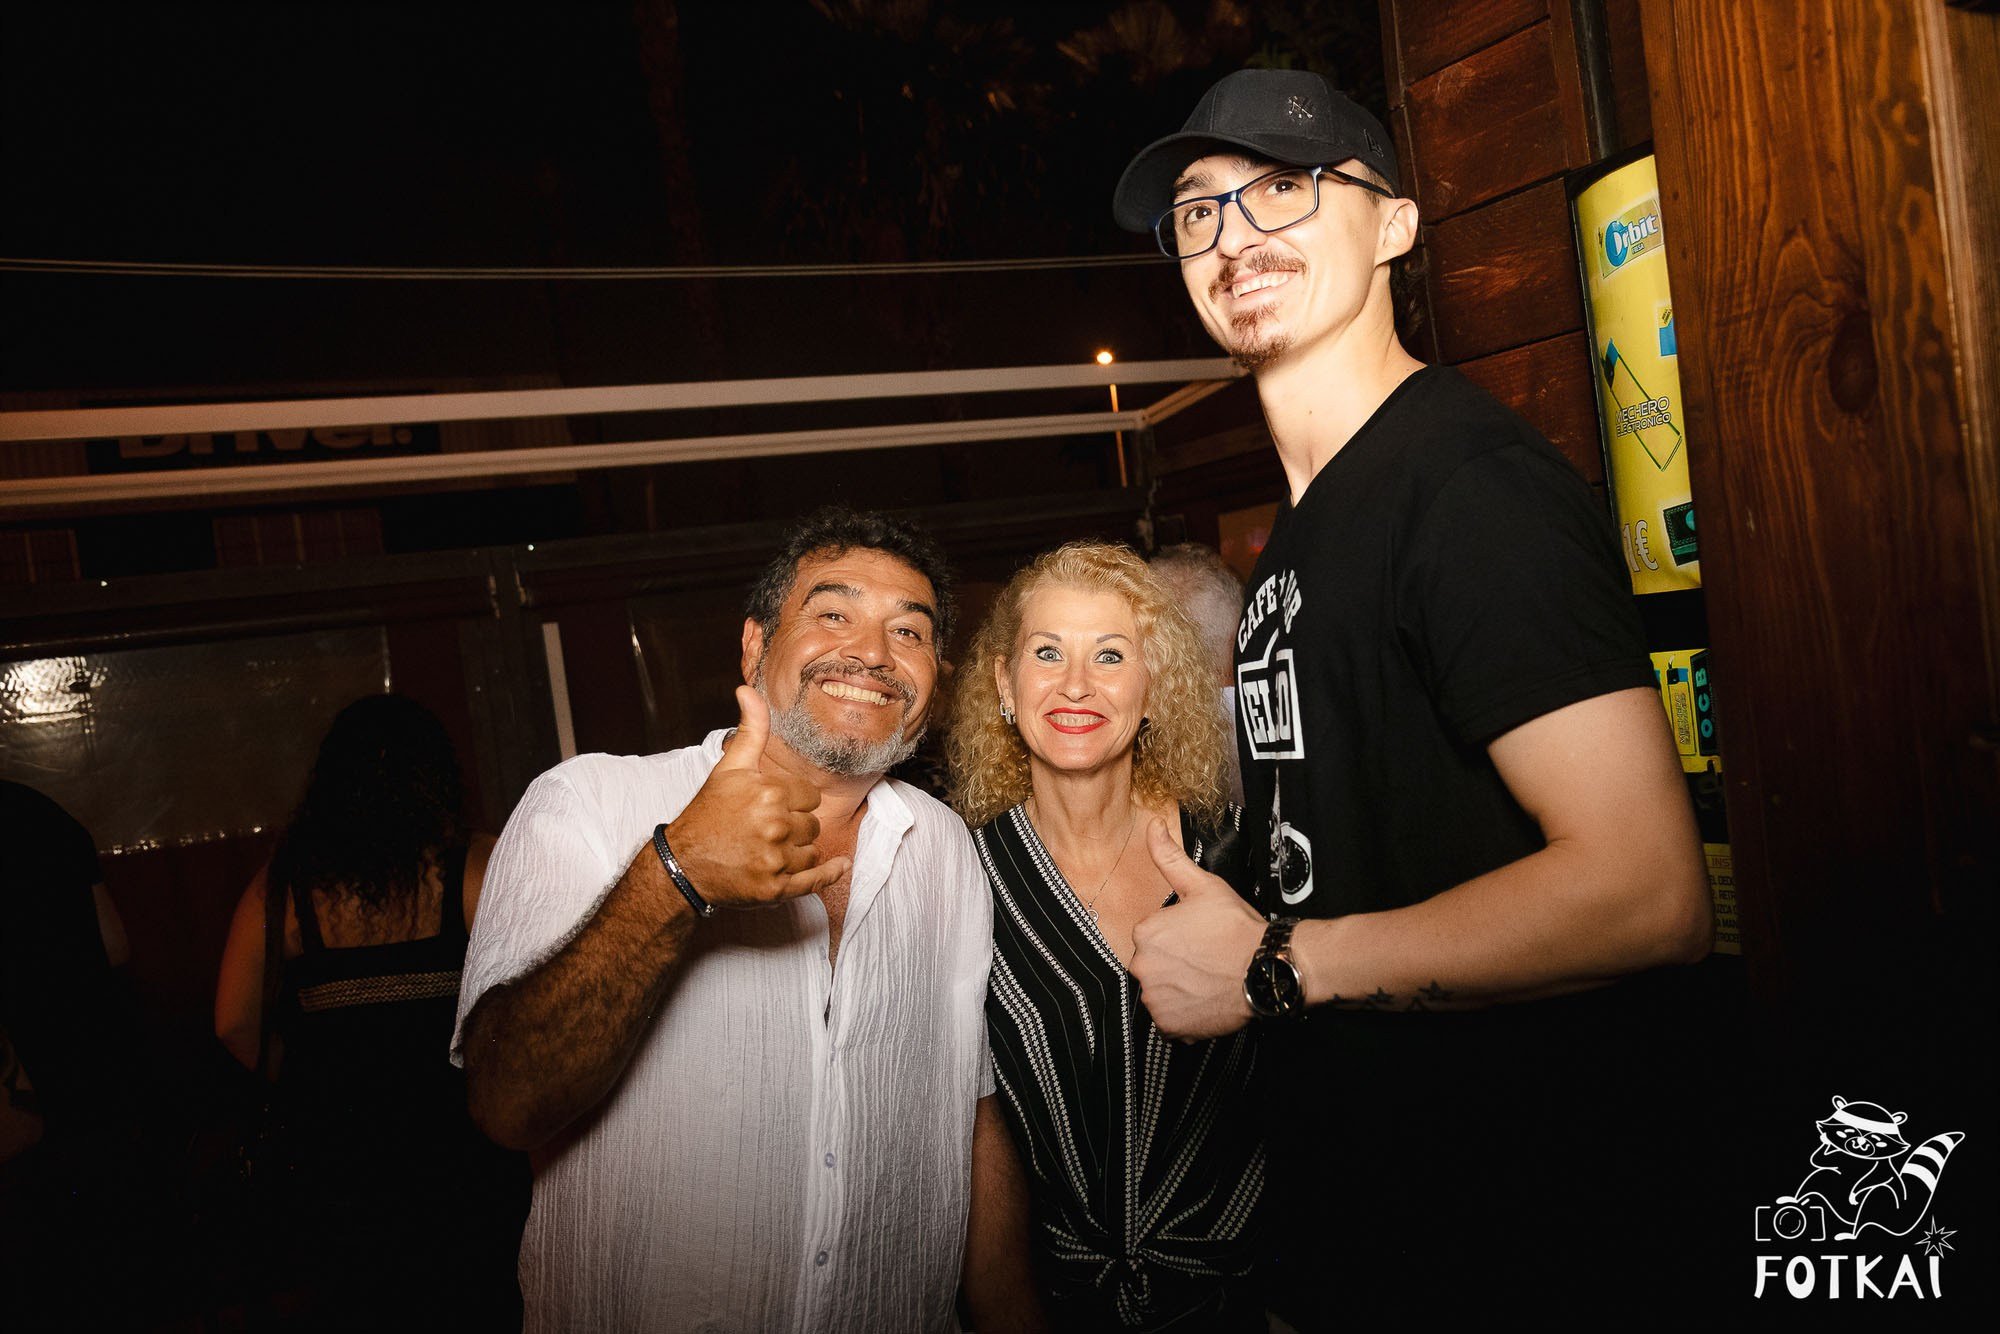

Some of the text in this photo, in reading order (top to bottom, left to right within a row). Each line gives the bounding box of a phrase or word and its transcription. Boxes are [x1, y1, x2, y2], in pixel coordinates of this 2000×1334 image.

[1605, 213, 1659, 268] Orbit
[1615, 396, 1669, 425] MECHERO
[1616, 411, 1671, 438] ELECTRONICO
[1237, 573, 1278, 655] CAFE
[1695, 667, 1713, 738] OCB
[1711, 857, 1731, 867] INS
